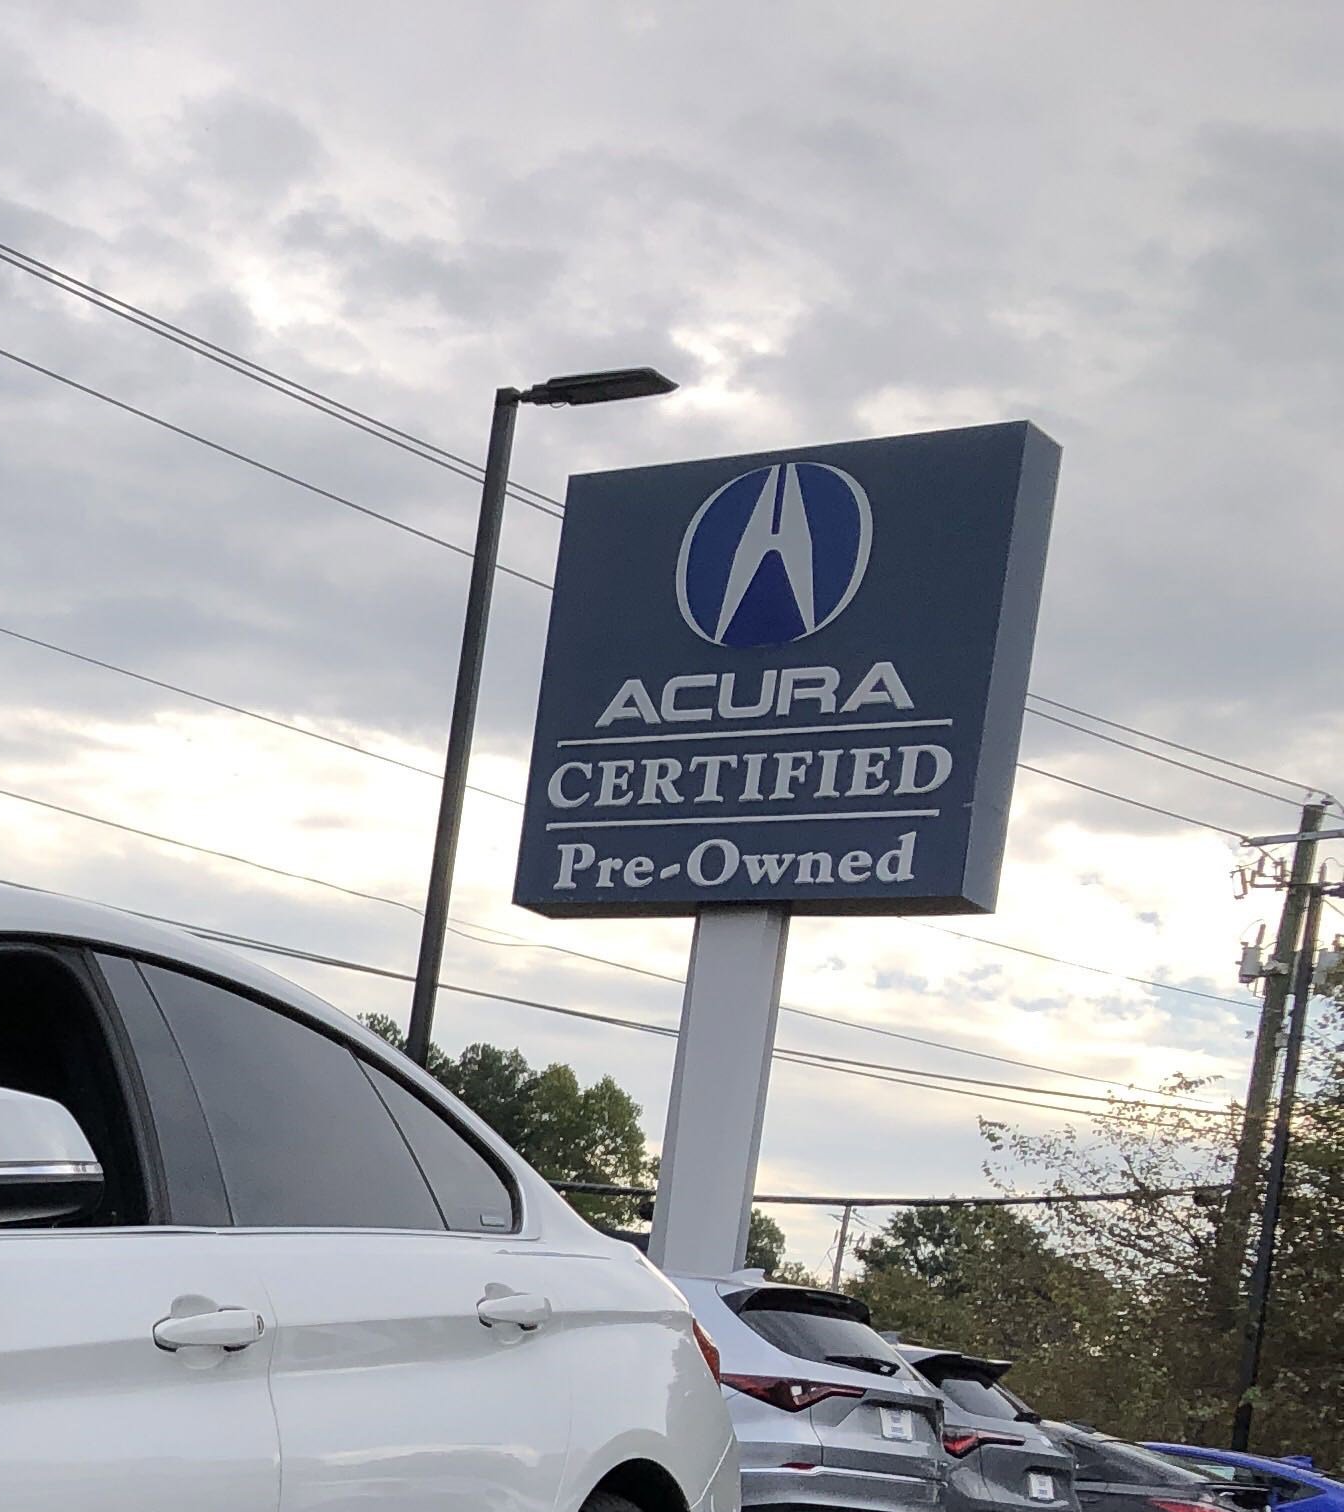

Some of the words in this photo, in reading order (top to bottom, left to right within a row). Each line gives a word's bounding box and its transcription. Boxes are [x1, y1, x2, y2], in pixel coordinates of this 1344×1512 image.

[595, 662, 914, 728] ACURA
[547, 744, 953, 809] CERTIFIED
[553, 831, 916, 890] Pre-Owned
